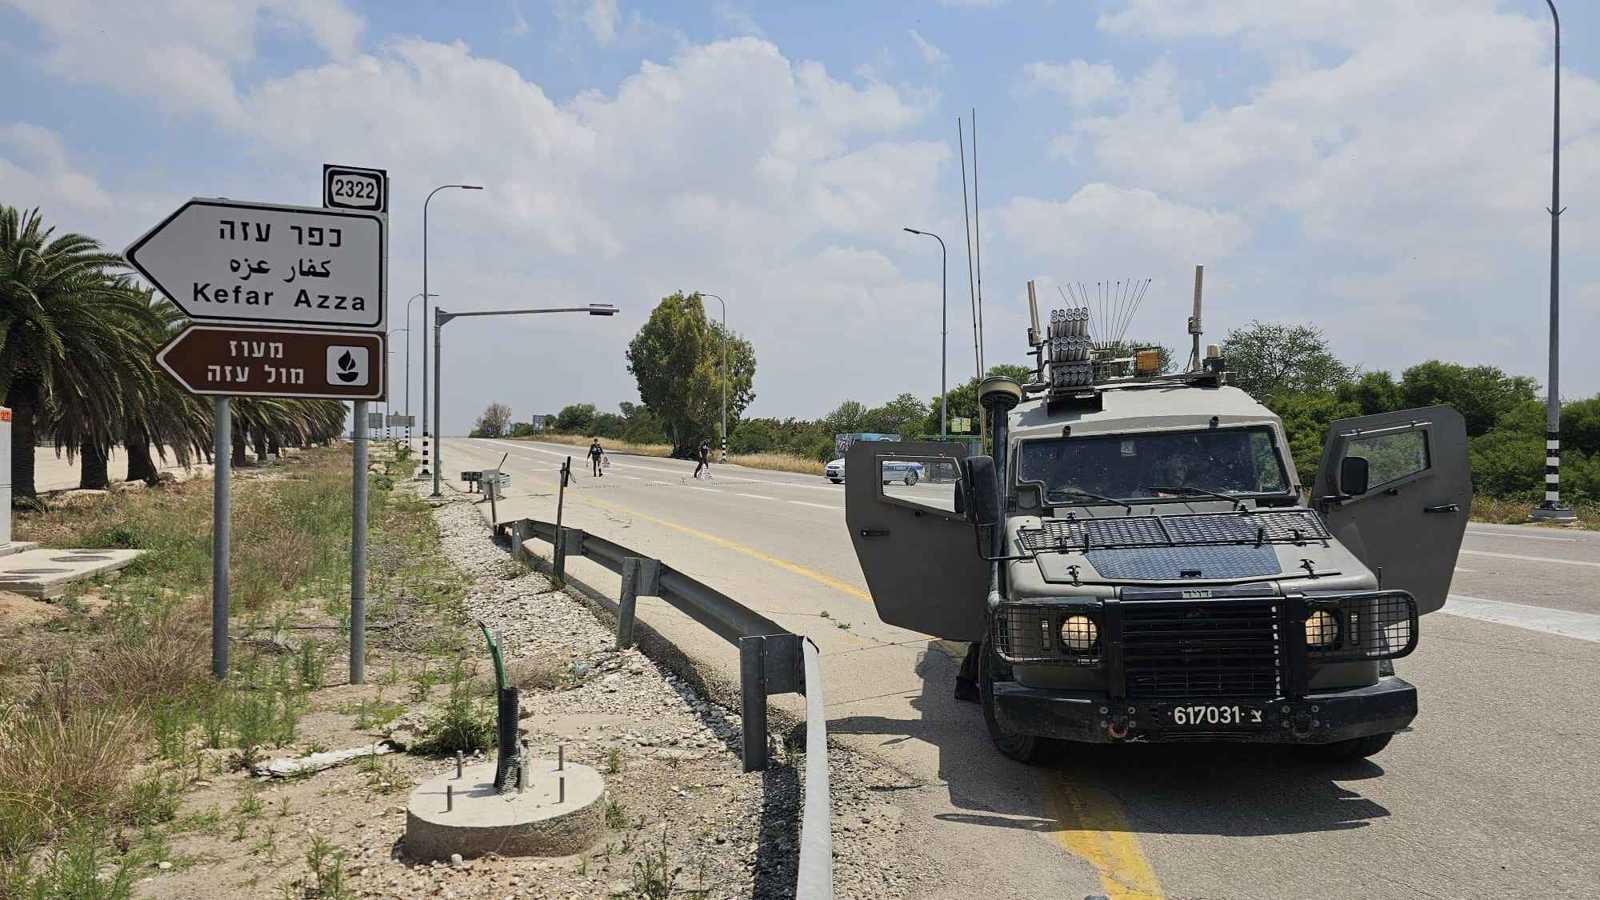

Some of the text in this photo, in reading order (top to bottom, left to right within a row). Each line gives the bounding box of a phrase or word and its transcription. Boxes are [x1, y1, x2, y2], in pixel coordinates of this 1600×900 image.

[335, 179, 375, 199] 2322
[219, 219, 342, 248] כפר עזה
[230, 257, 331, 282] كفار عزه
[193, 282, 365, 311] Kefar Azza
[229, 340, 284, 359] מעוז
[208, 365, 304, 385] מול עזה
[1174, 706, 1240, 725] 617031
